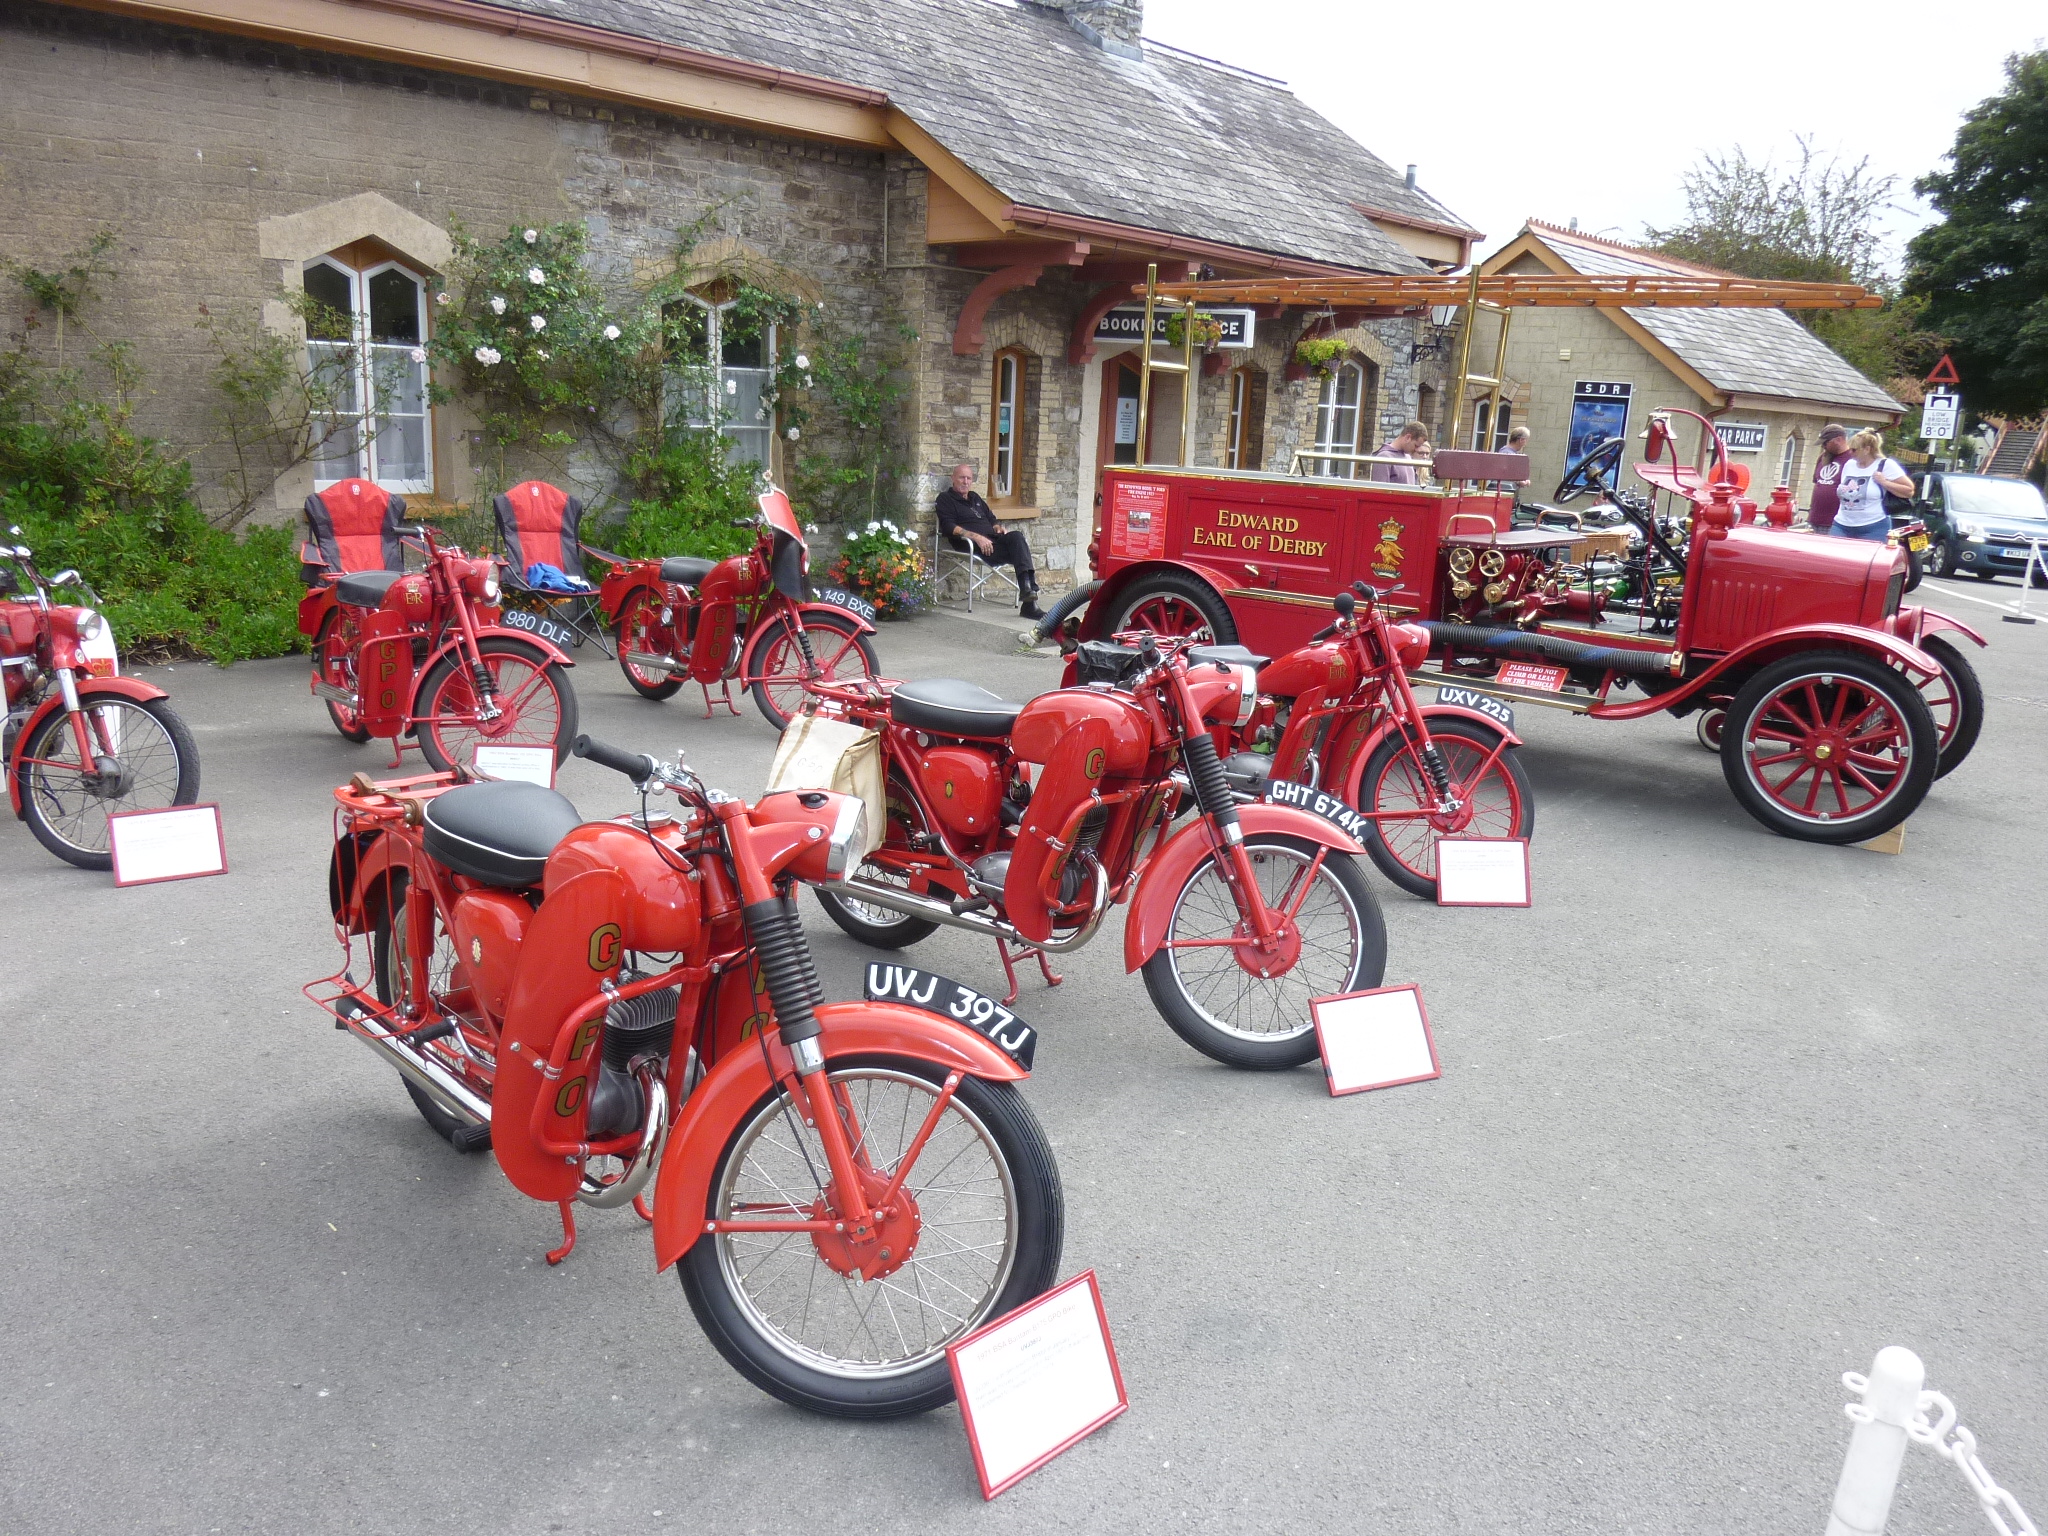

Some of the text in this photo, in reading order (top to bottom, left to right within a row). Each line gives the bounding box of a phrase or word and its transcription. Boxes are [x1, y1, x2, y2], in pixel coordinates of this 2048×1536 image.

[1098, 317, 1166, 333] BOOKIG
[1717, 429, 1755, 445] CAR PARK
[1217, 509, 1299, 533] EDWARD
[1192, 527, 1327, 557] EARL OF DERBY
[825, 590, 875, 620] 149 BXE
[506, 611, 572, 644] 980 DLF
[380, 641, 397, 709] GPO
[1506, 670, 1527, 678] CLIMB
[1537, 674, 1556, 682] LEAN
[1509, 664, 1533, 673] PLEASE
[1544, 668, 1558, 676] NOT
[1513, 677, 1526, 685] THE
[1527, 679, 1554, 688] VEHICLE
[1440, 687, 1512, 723] UXV 225
[1272, 781, 1367, 837] GHT 674K
[555, 922, 622, 1117] GPO
[869, 964, 1031, 1051] UVJ 397J
